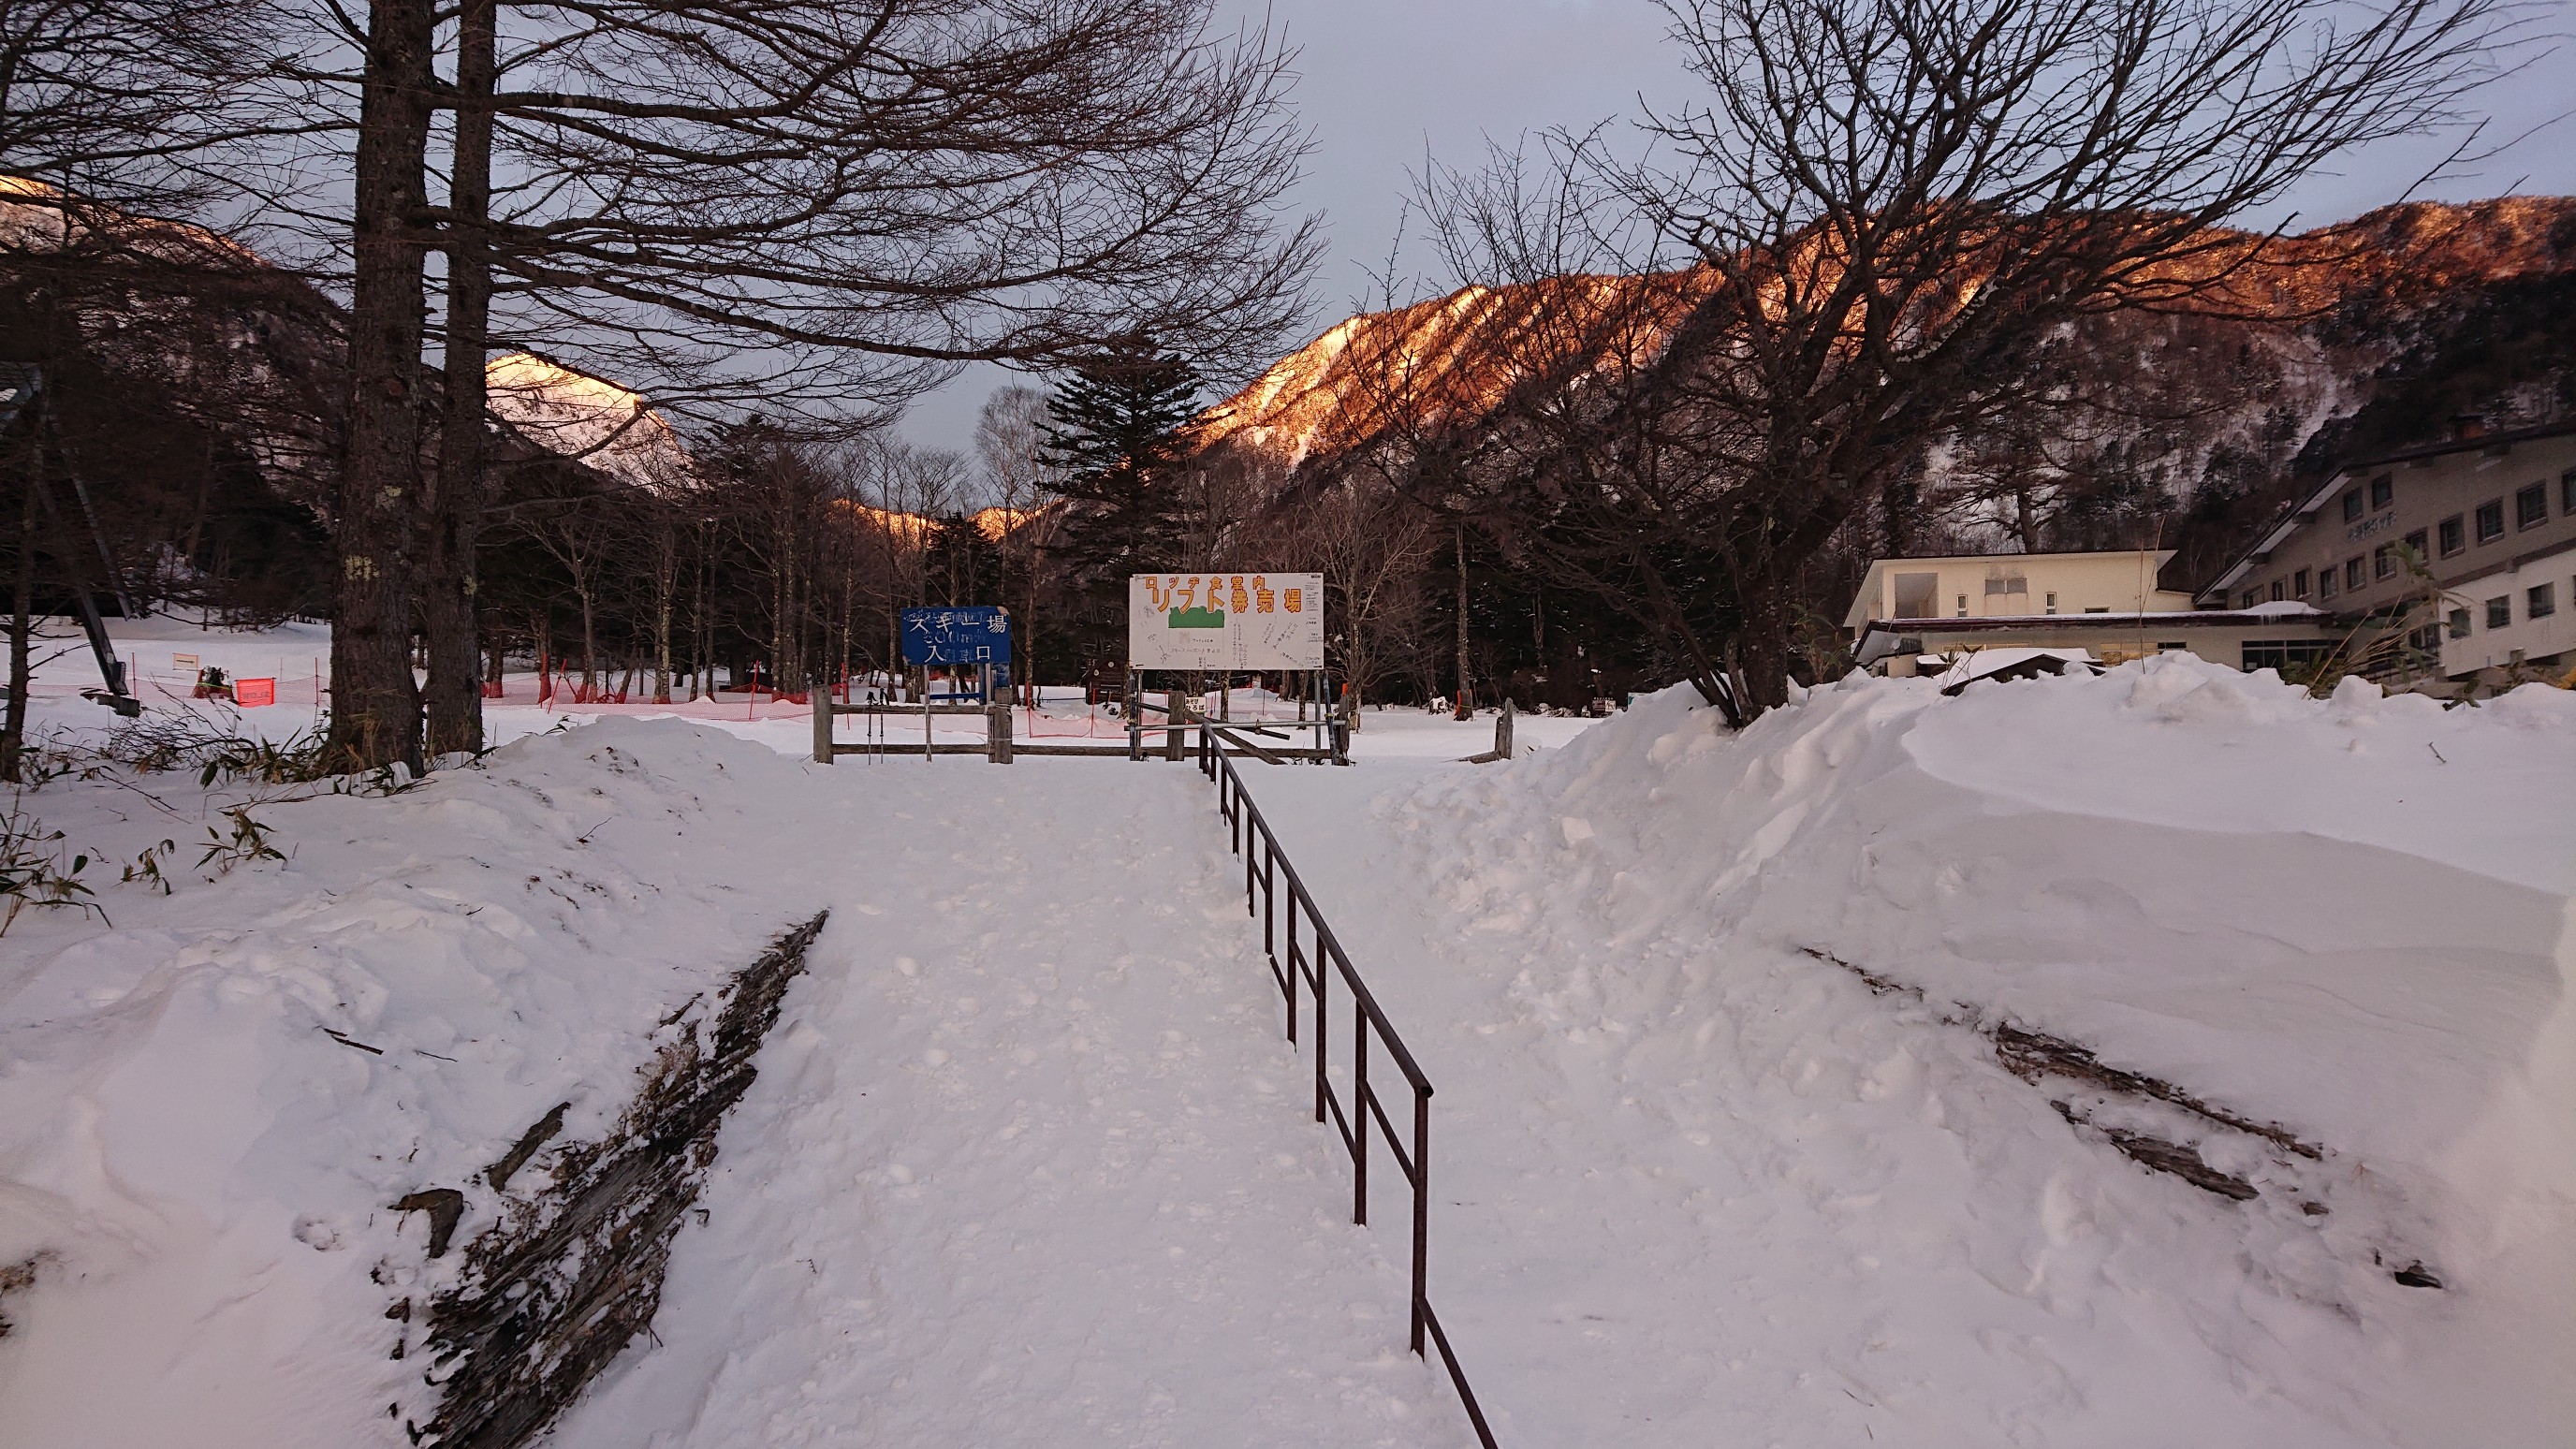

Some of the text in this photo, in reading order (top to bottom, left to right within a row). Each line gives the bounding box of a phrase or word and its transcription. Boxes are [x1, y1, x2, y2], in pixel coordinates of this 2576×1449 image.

[1152, 588, 1302, 614] リフト券売場
[924, 645, 990, 663] 入口
